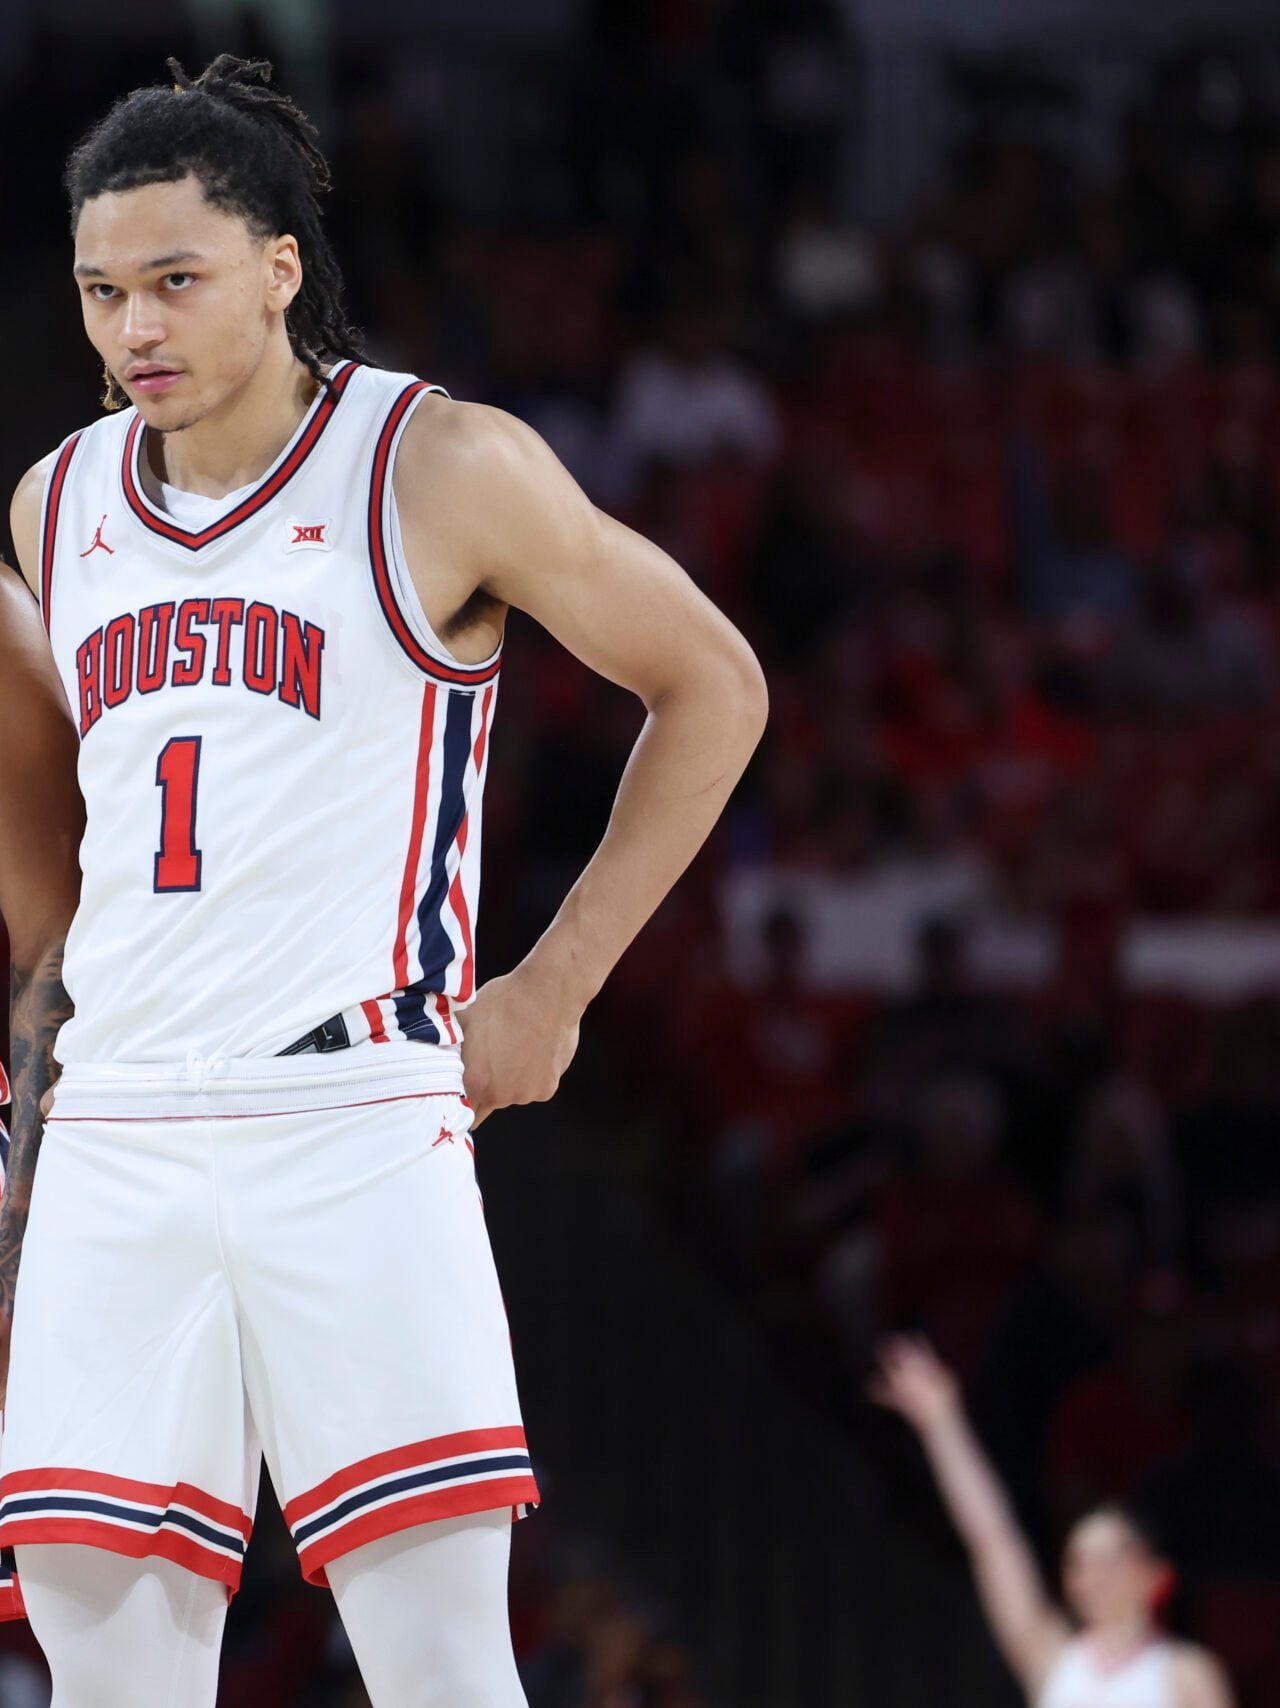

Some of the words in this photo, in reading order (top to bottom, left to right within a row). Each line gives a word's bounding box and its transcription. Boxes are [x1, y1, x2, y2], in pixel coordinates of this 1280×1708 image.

[291, 524, 326, 543] XII
[76, 597, 325, 740] HOUSTON
[154, 736, 202, 893] 1
